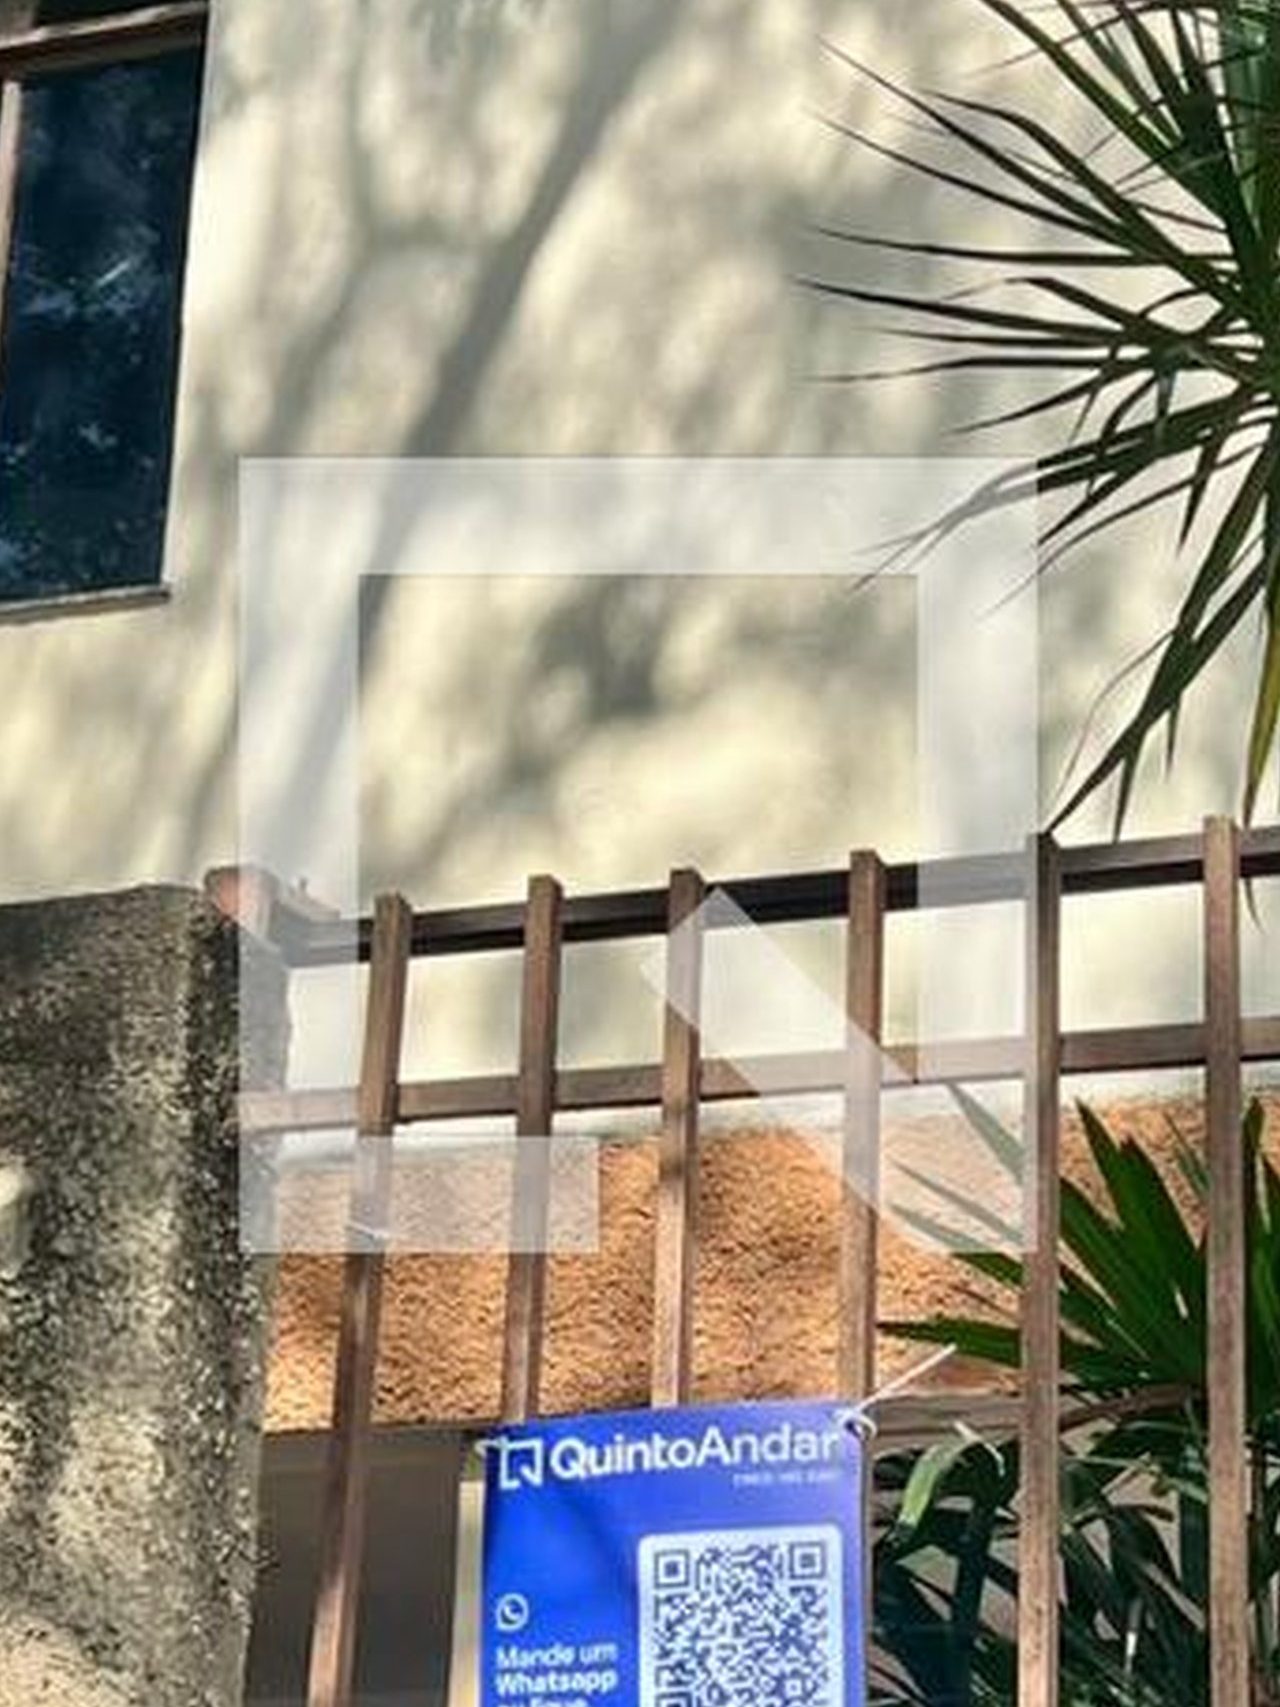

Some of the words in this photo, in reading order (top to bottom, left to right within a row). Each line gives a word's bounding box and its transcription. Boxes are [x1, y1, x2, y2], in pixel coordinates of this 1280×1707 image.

[549, 1423, 839, 1480] QuintoAndar
[495, 1642, 576, 1669] Mande
[579, 1642, 618, 1665] um
[495, 1670, 618, 1697] Whatsapp
